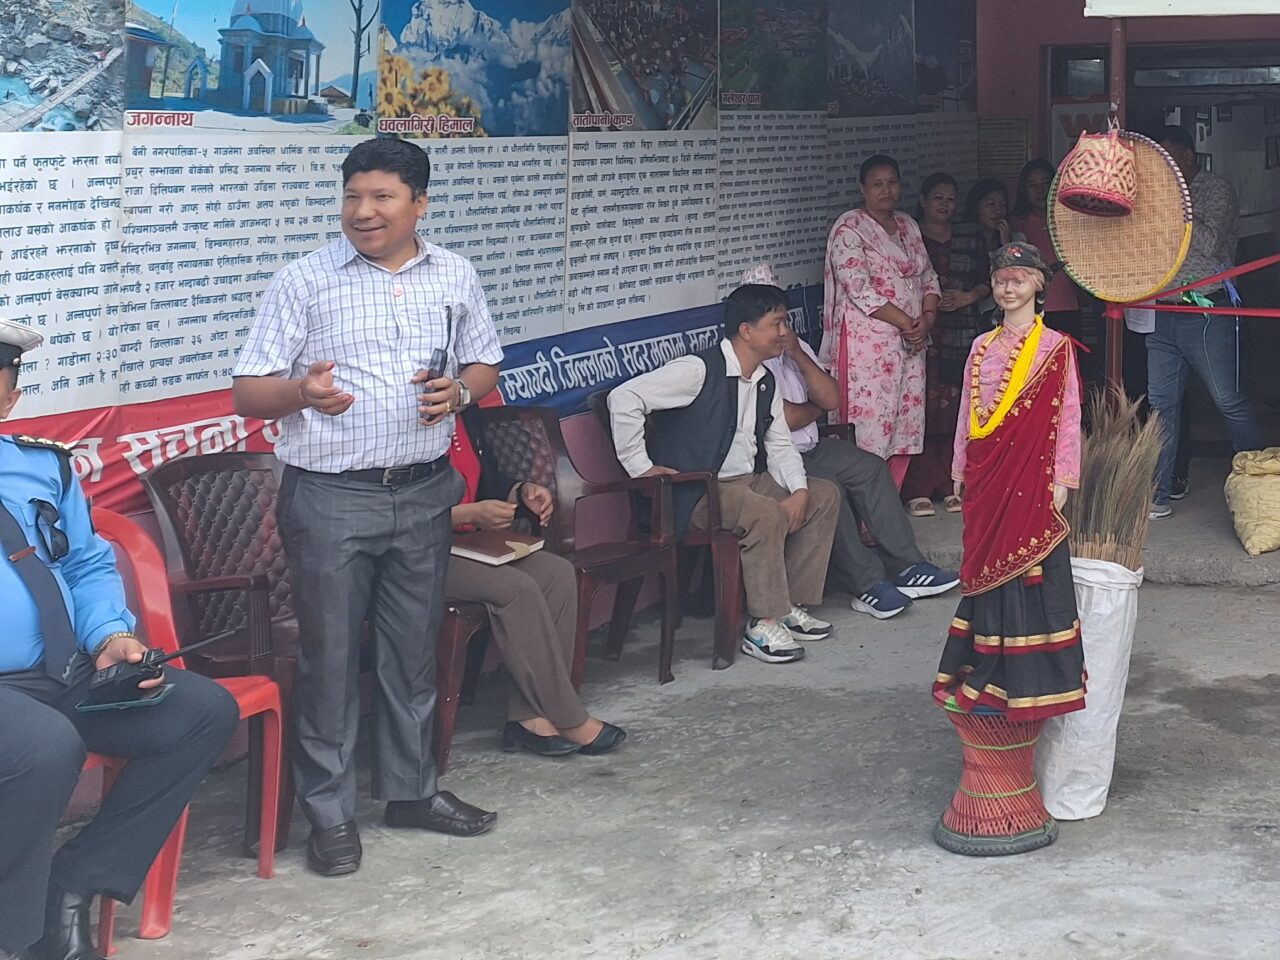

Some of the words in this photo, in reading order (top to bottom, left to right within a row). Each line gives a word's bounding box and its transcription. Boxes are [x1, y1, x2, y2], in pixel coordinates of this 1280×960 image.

[126, 111, 195, 128] जगन्नाथ
[438, 115, 474, 133] हिमाल
[72, 155, 99, 167] झरना
[48, 198, 87, 212] मनमोहक
[27, 221, 55, 236] यसको
[59, 218, 97, 233] आकर्षक
[101, 217, 112, 231] हो
[56, 241, 97, 256] झरनाको
[78, 261, 96, 275] पनि
[57, 351, 92, 367] गाडीमा
[51, 376, 70, 392] अनि
[77, 372, 95, 386] जाने
[501, 350, 556, 400] म्याग्दी
